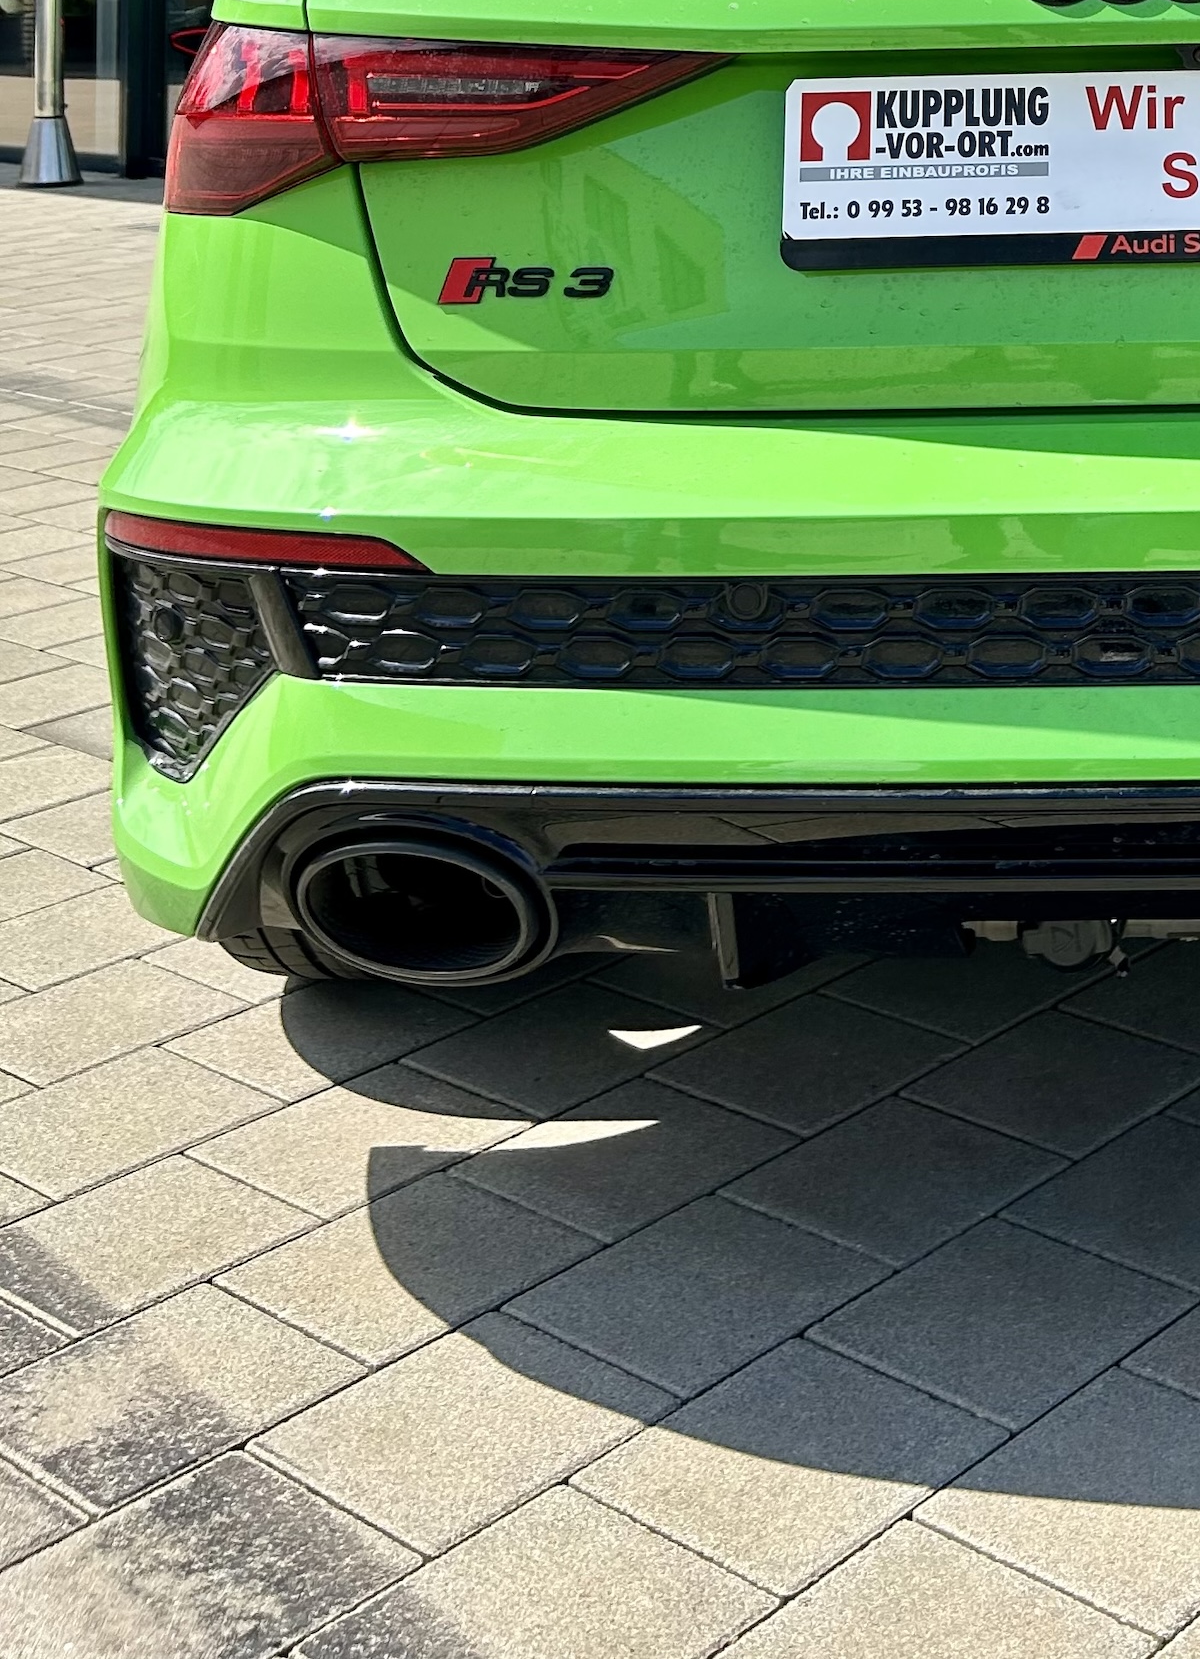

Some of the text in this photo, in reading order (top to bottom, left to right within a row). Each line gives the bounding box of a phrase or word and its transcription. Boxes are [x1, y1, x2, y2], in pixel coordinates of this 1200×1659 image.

[876, 87, 1050, 129] KUPPLUNG
[1086, 84, 1185, 131] Wir
[875, 130, 1050, 160] -VOR-ORT.com
[829, 164, 1019, 180] IHRE EINBAUPROFIS
[800, 201, 839, 220] Tel.:
[847, 201, 860, 219] 0
[868, 200, 894, 218] 99
[901, 199, 923, 217] 53
[945, 198, 971, 216] 98
[978, 197, 999, 215] 16
[1006, 196, 1029, 215] 29
[1037, 196, 1050, 214] 8
[1110, 233, 1176, 255] Audi
[463, 267, 615, 298] RS 3
